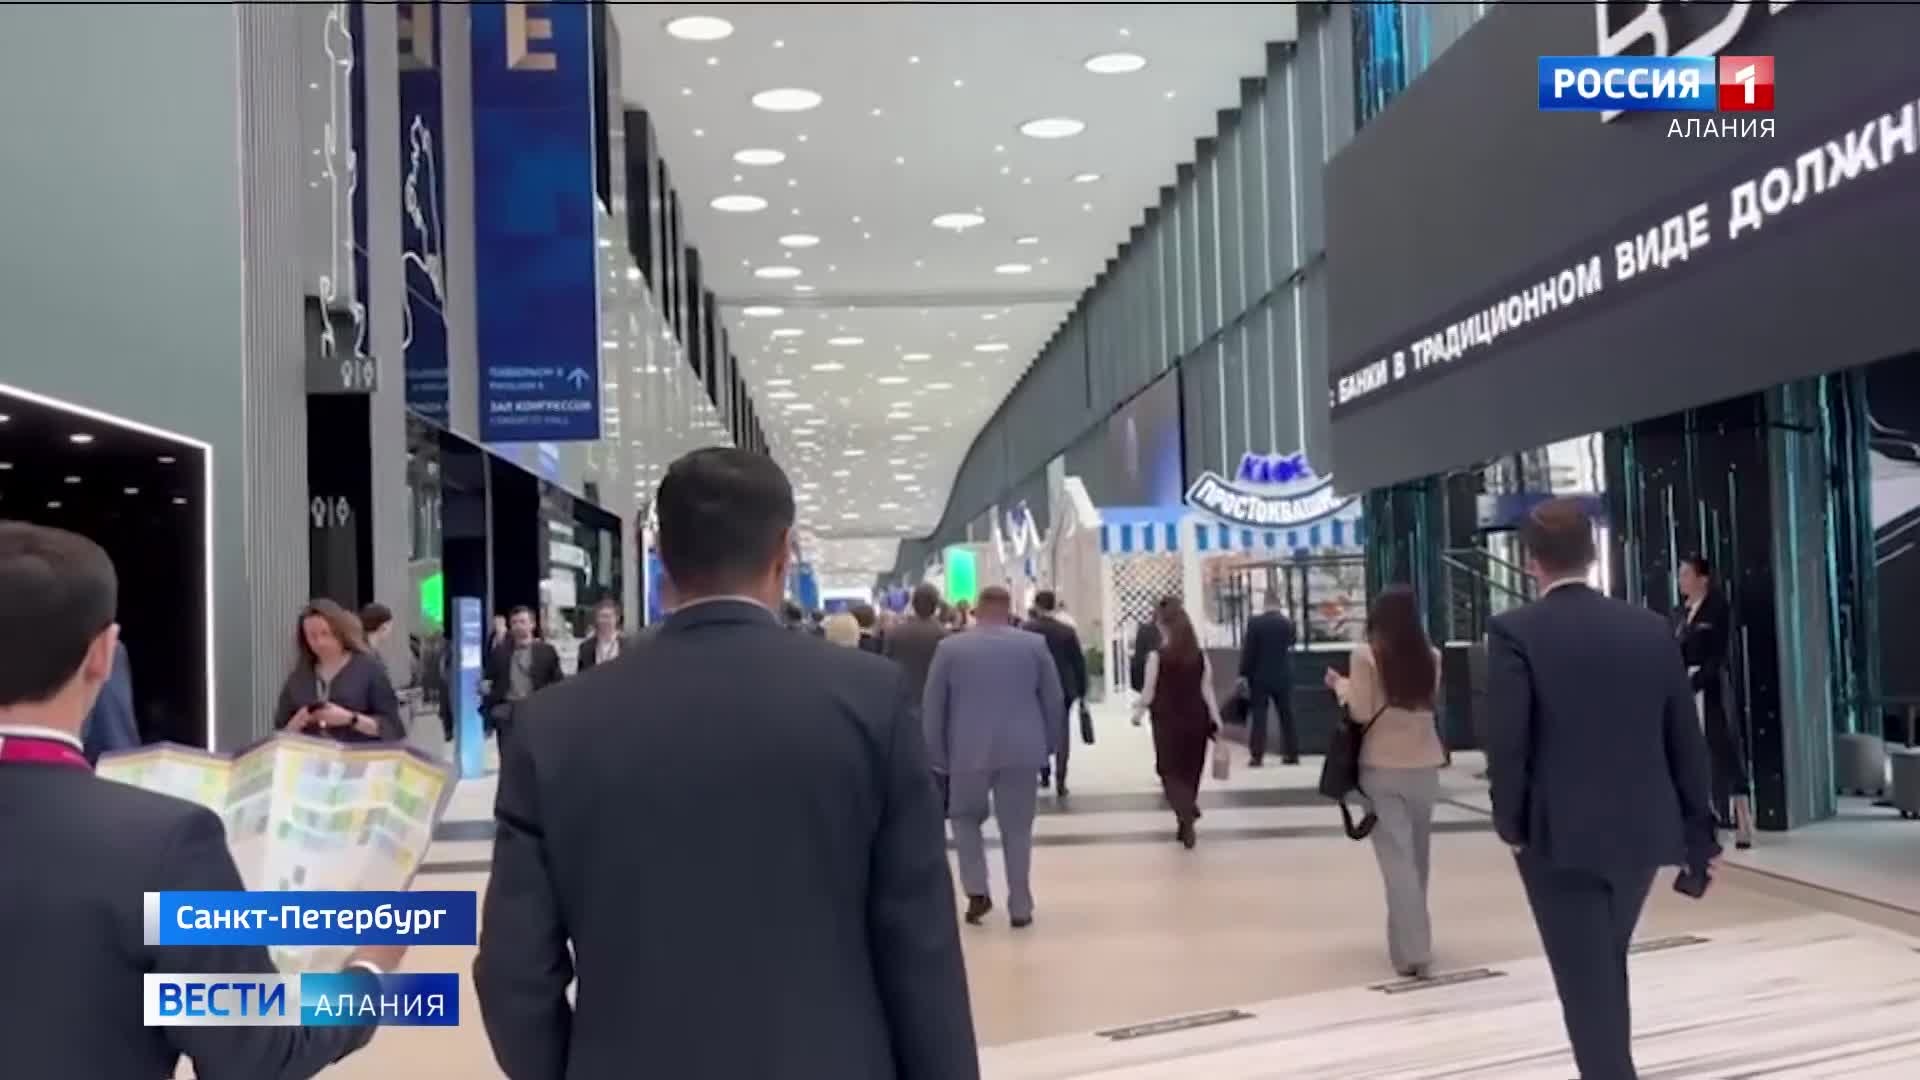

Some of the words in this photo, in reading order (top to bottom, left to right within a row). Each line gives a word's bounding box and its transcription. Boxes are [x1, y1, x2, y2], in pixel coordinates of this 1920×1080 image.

[1338, 359, 1389, 405] БАНКИ
[1393, 351, 1406, 381] В
[1411, 255, 1604, 370] ТРАДИЦИОННОМ
[1614, 202, 1711, 281] ВИДЕ
[1728, 98, 1920, 240] ДОЛЖН
